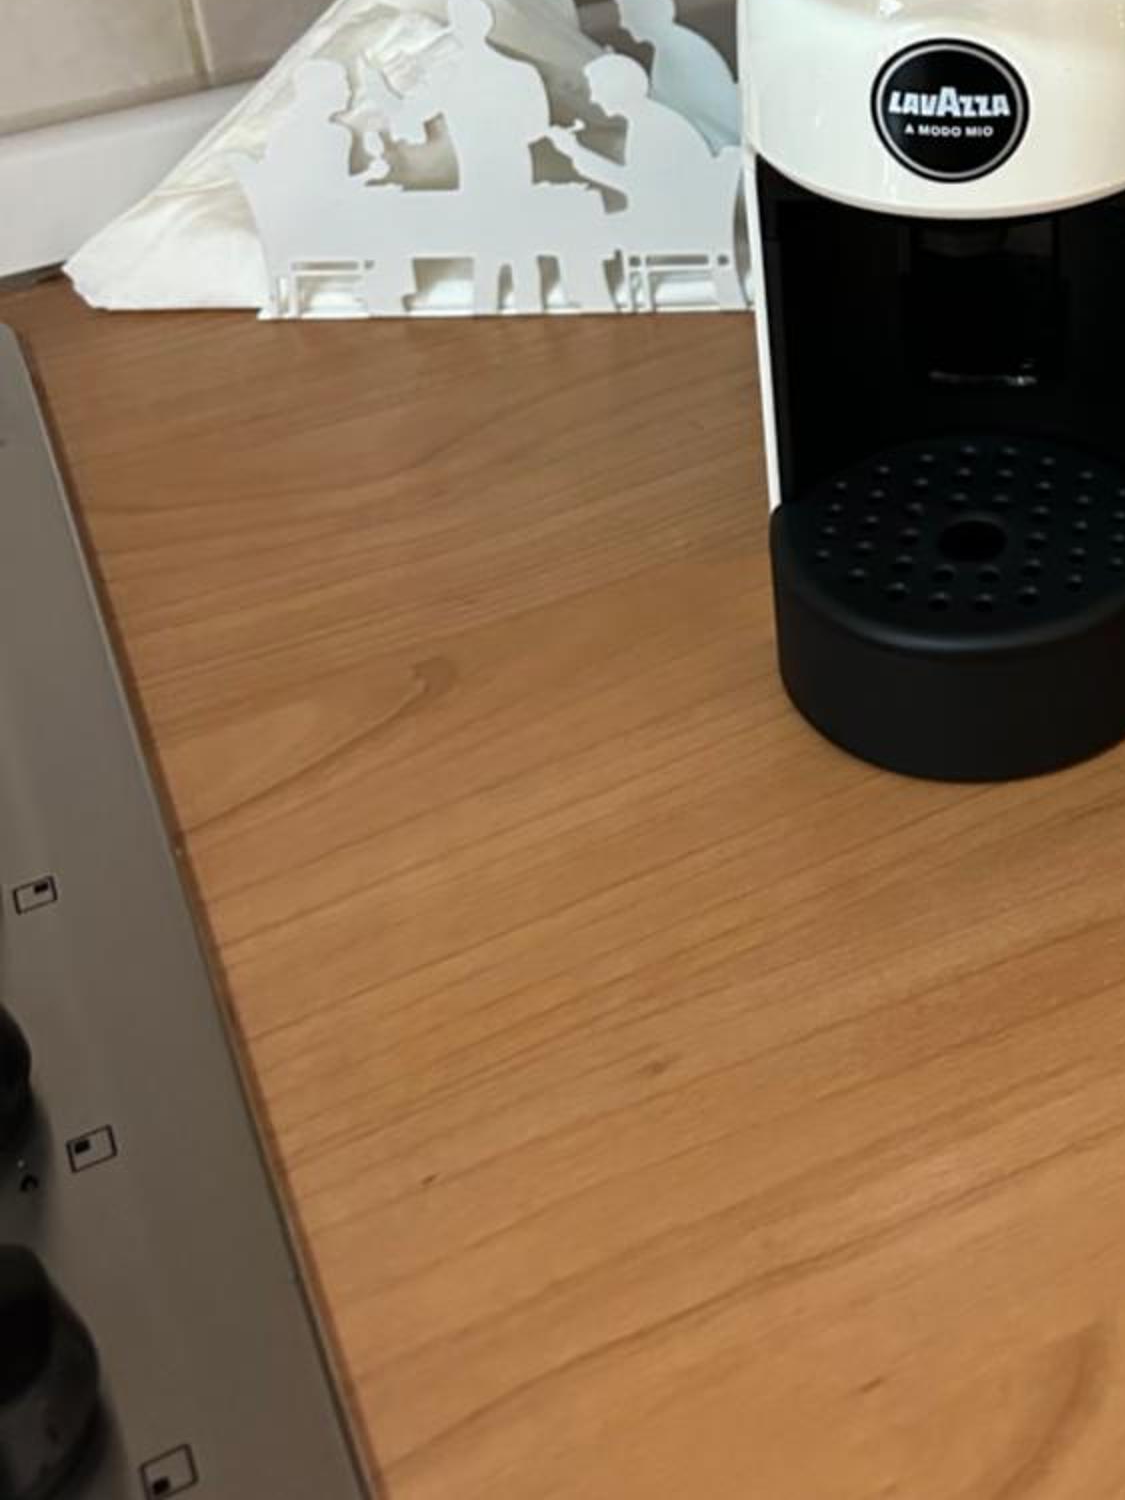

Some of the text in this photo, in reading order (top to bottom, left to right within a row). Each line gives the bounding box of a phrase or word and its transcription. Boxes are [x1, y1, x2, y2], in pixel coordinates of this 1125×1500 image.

[887, 86, 1011, 117] LAVAZZA
[904, 123, 994, 137] A MODO MIO
